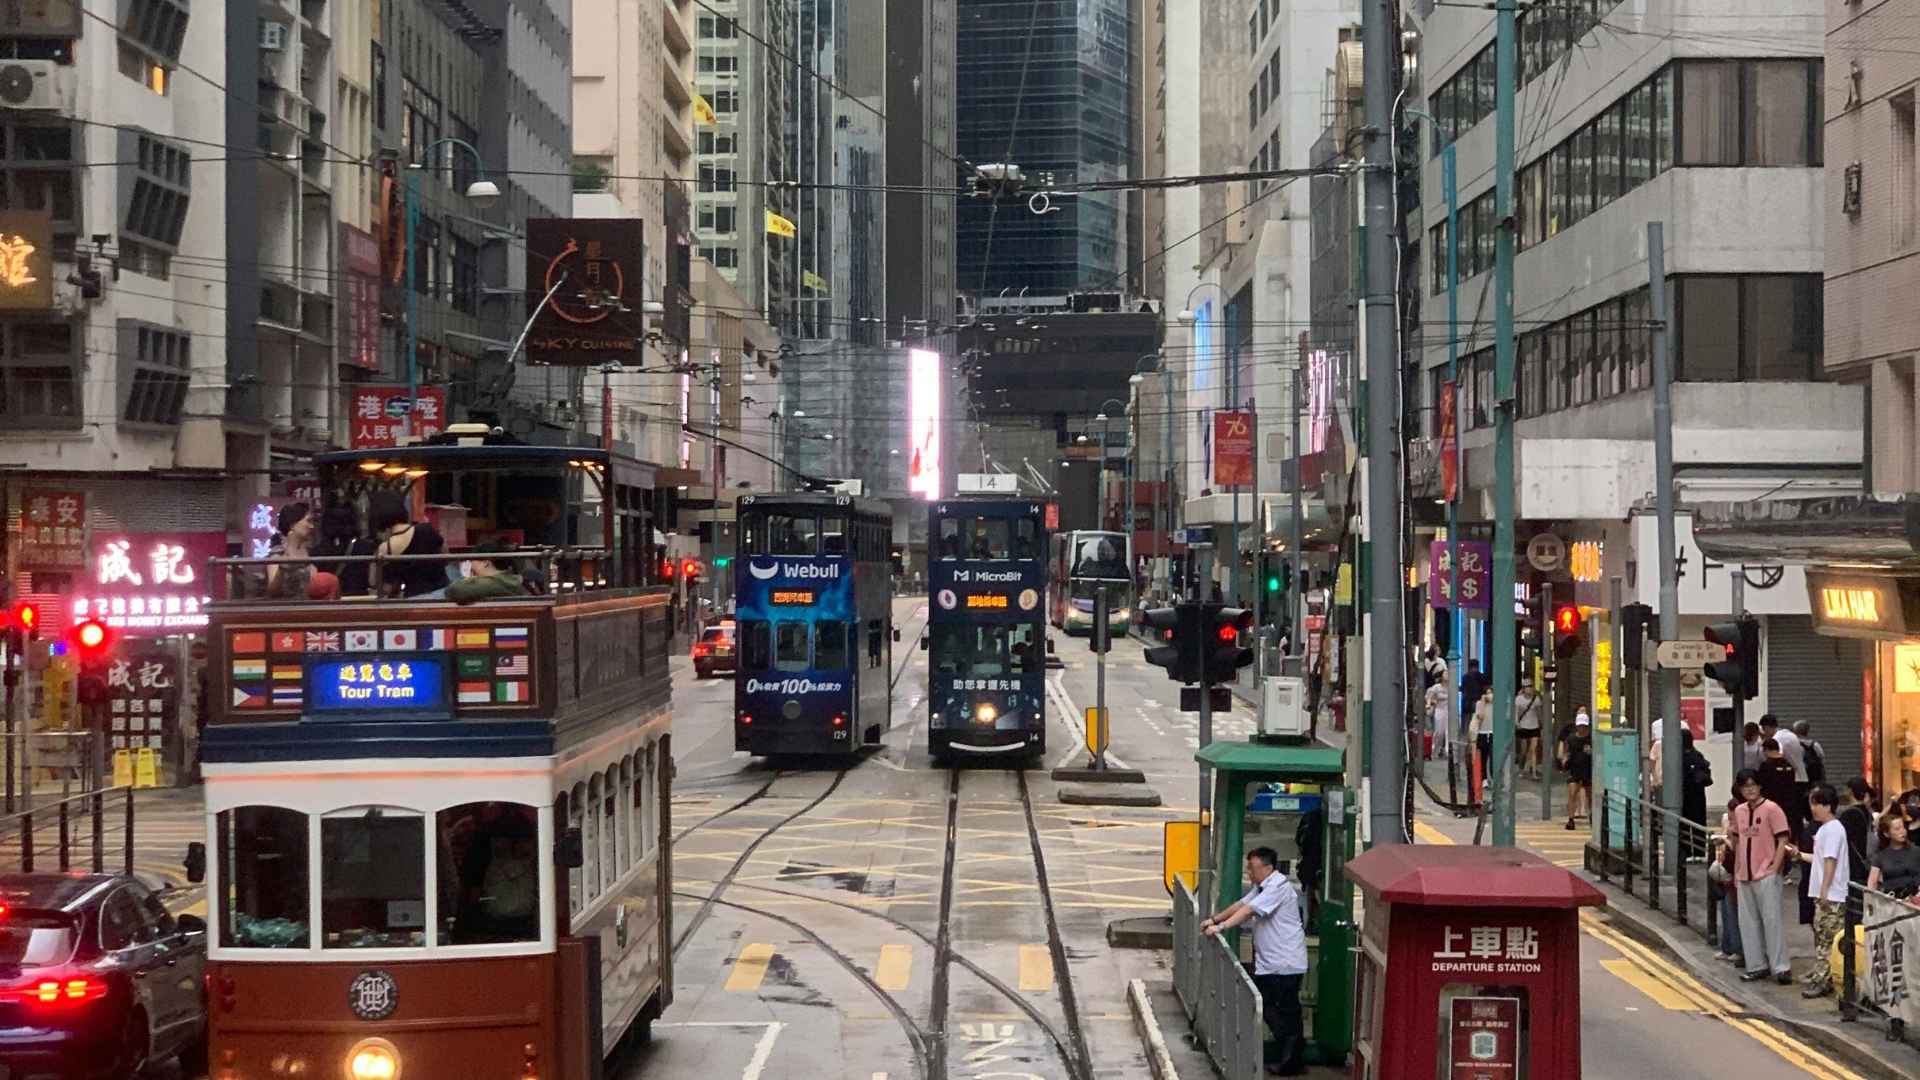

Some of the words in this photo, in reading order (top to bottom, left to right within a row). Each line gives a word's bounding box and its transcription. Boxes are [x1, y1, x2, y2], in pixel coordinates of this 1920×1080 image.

[1225, 416, 1248, 438] 76
[979, 475, 998, 489] 14
[741, 495, 755, 505] 129
[835, 495, 850, 505] 129
[937, 504, 947, 514] 14
[1030, 504, 1040, 514] 14
[783, 563, 839, 579] Webull
[975, 572, 1022, 582] MicroBit
[1462, 577, 1478, 600] $
[339, 685, 373, 699] Tour
[376, 684, 415, 698] Tram
[832, 729, 847, 740] 129
[1433, 925, 1539, 960] 上車點
[1431, 962, 1494, 972] DEPARTURE
[1497, 963, 1542, 973] STATION
